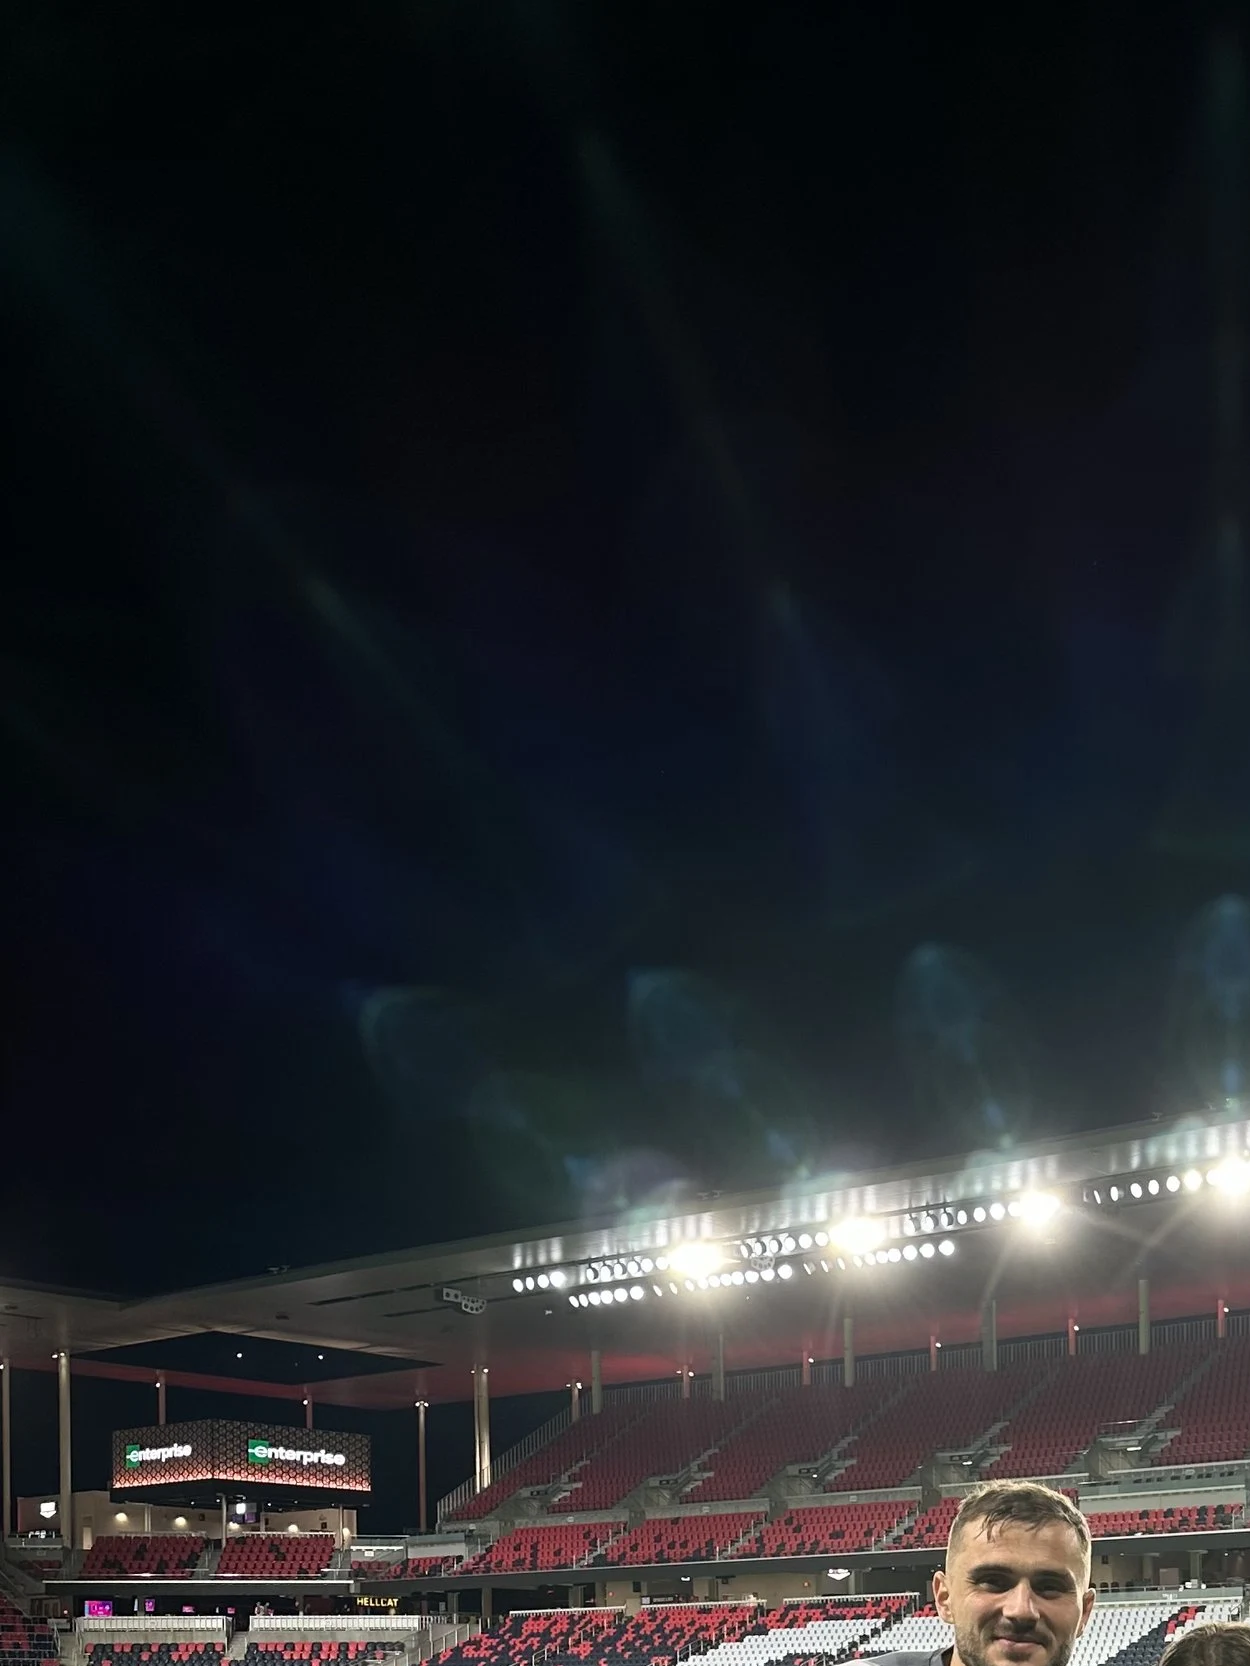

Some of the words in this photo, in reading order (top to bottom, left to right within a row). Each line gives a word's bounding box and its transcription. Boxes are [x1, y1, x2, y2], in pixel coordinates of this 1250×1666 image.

[127, 1443, 192, 1463] enterprise
[248, 1444, 346, 1466] enterprise
[356, 1597, 399, 1607] HELLCAT
